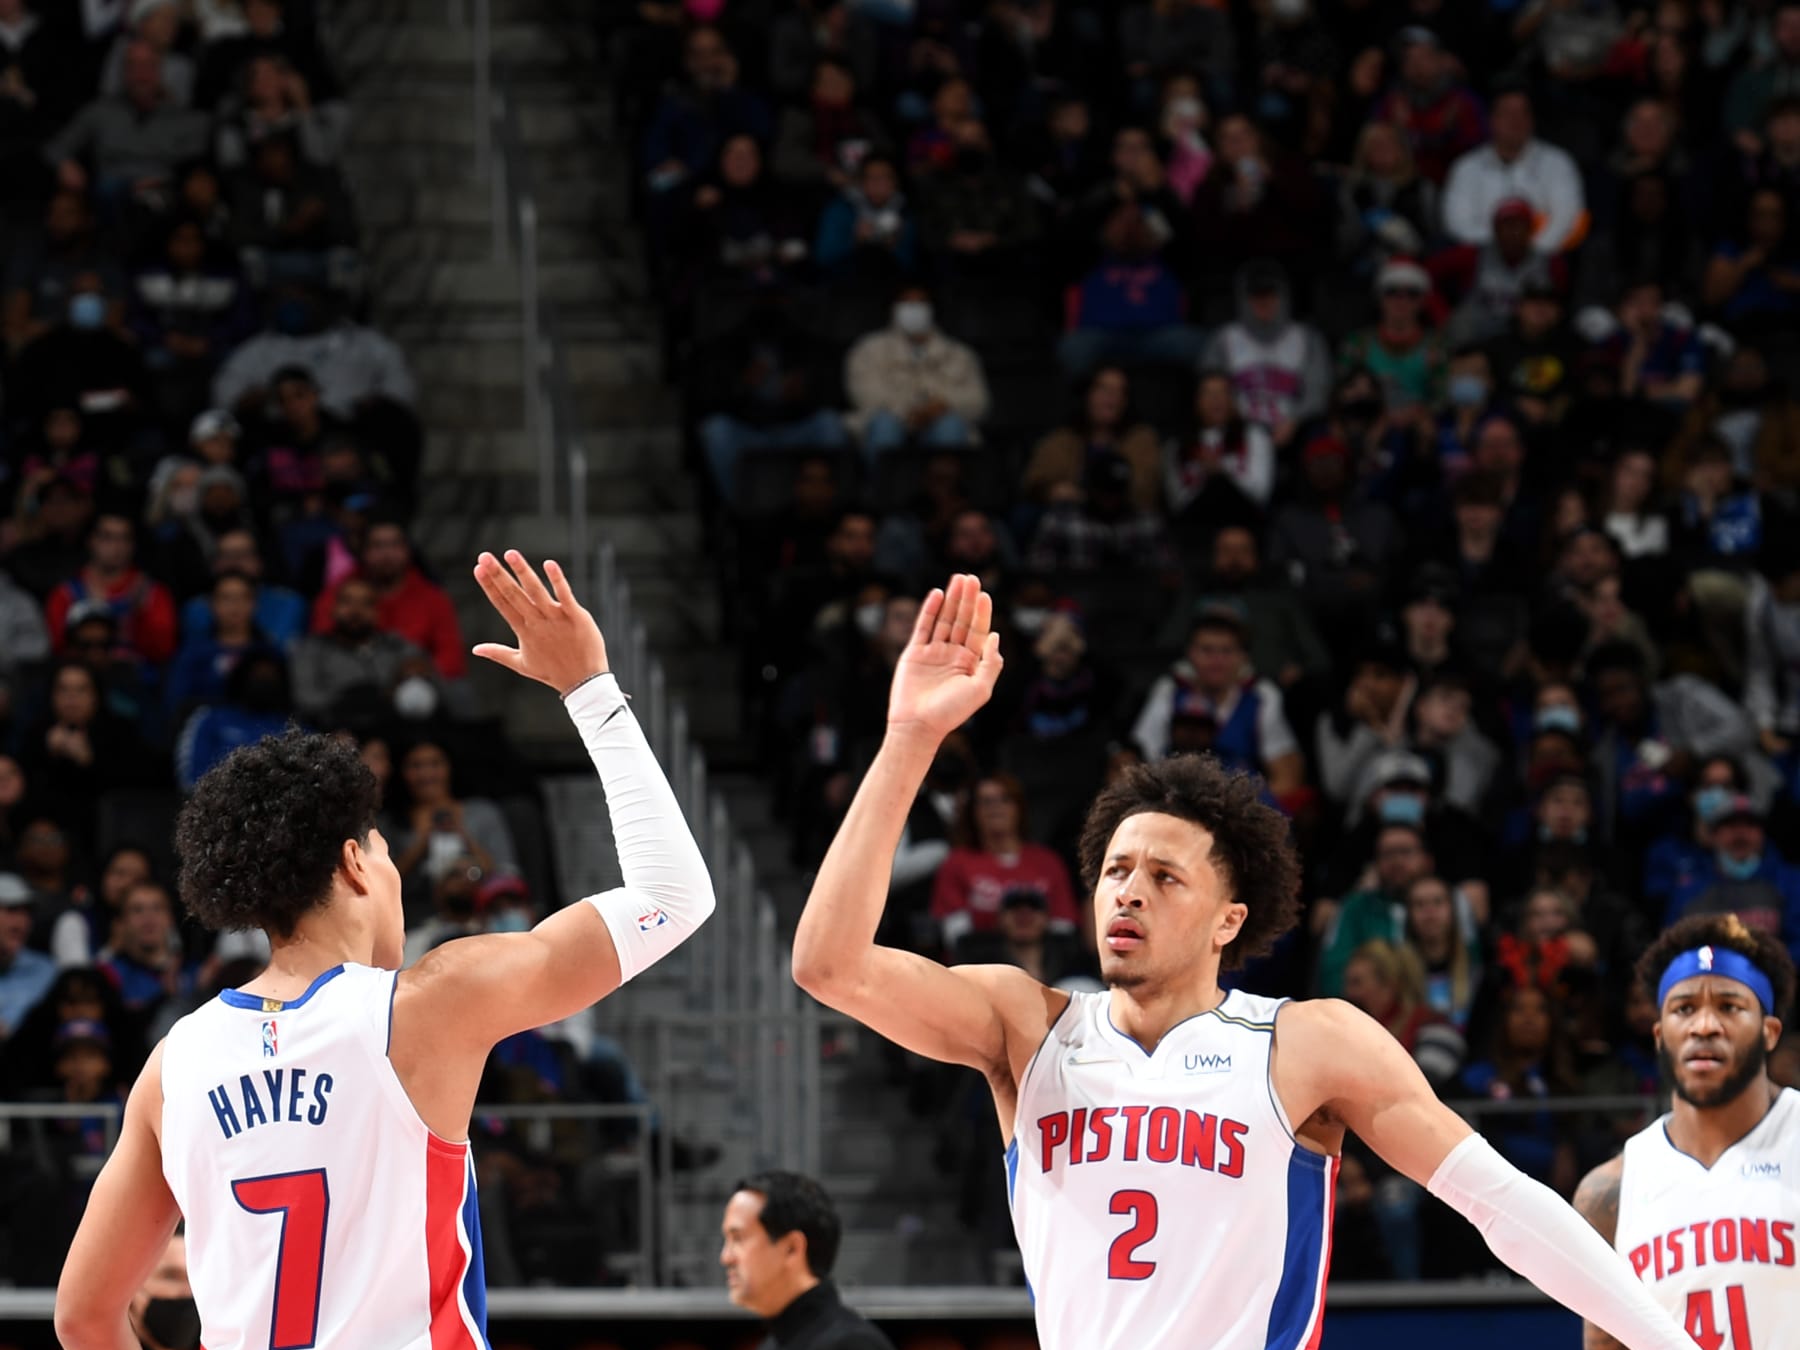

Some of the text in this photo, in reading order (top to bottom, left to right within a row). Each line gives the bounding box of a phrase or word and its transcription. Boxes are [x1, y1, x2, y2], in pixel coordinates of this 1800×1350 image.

[1184, 1054, 1231, 1070] UWM
[208, 1068, 333, 1139] HAYES
[1037, 1105, 1249, 1178] PISTONS
[1108, 1189, 1158, 1280] 2
[1628, 1217, 1796, 1284] PISTONS
